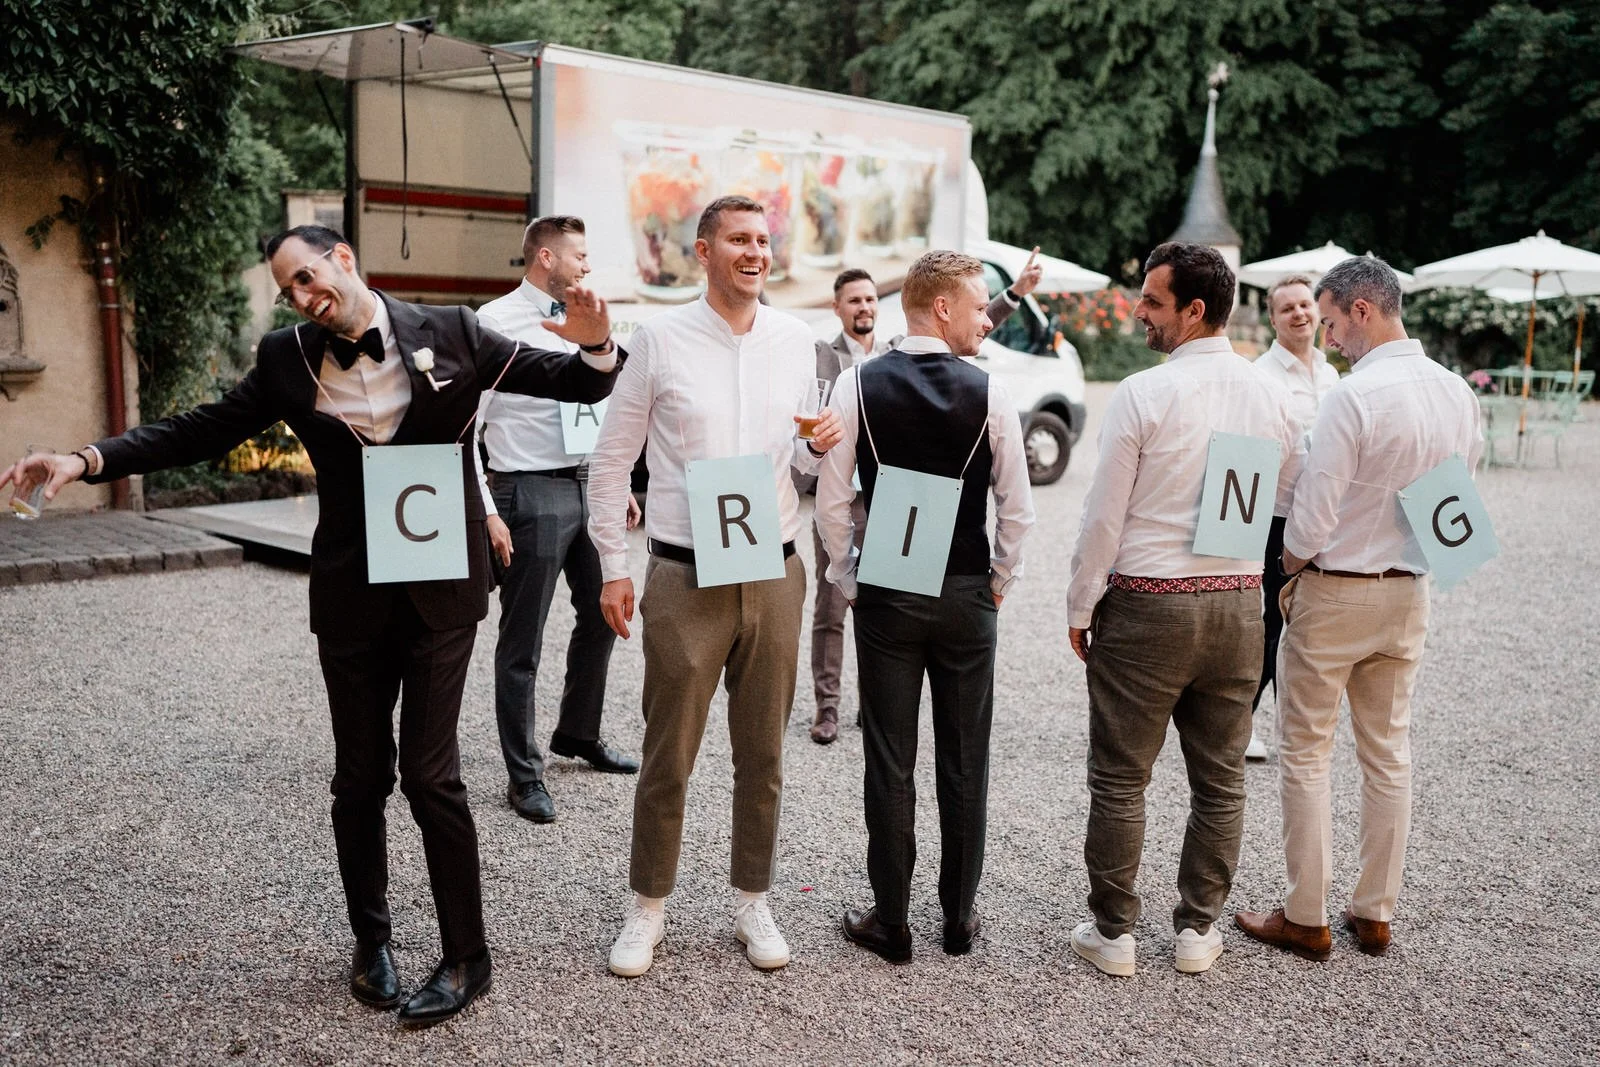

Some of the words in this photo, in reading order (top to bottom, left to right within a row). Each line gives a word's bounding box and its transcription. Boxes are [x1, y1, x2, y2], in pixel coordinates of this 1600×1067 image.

[574, 403, 600, 428] A
[394, 483, 439, 543] C
[717, 493, 758, 549] R
[1219, 468, 1261, 525] N
[1431, 495, 1474, 548] G
[901, 505, 919, 557] I
